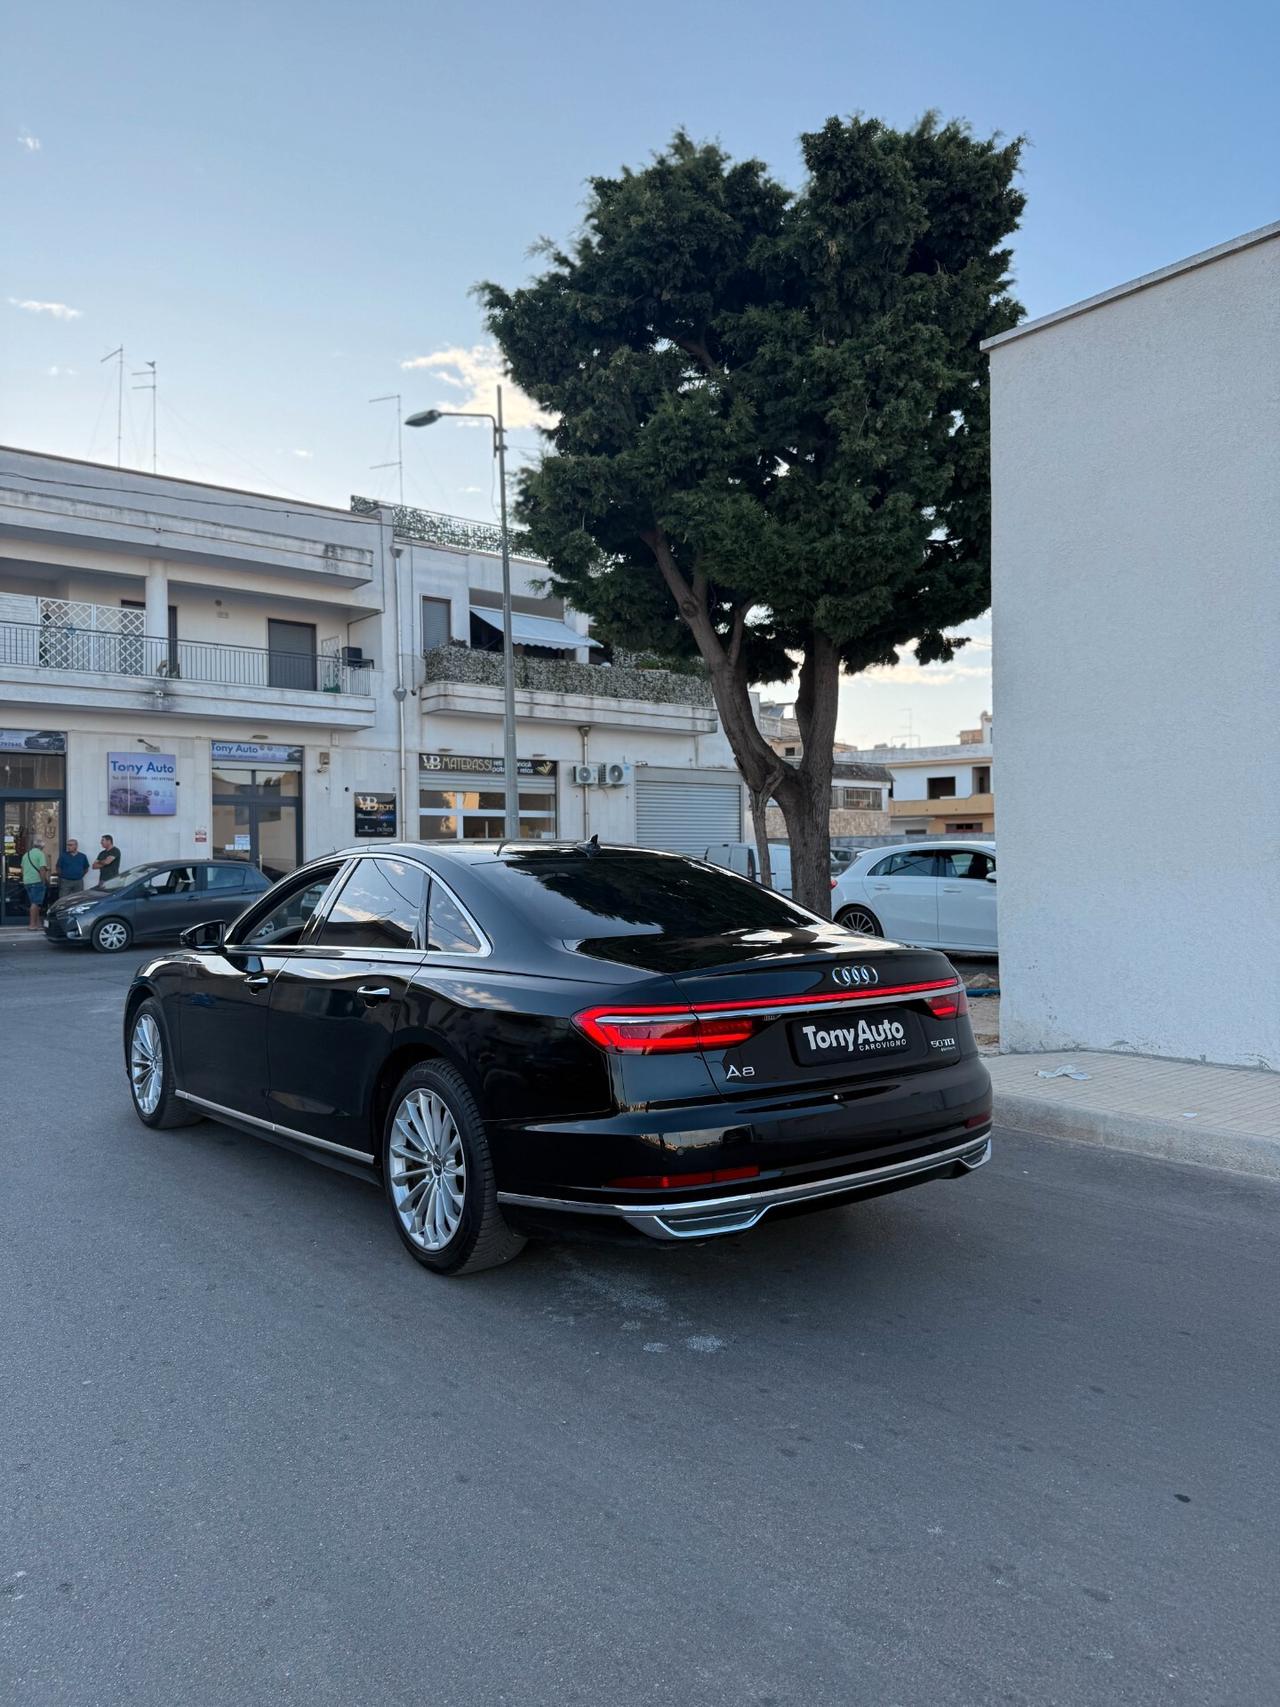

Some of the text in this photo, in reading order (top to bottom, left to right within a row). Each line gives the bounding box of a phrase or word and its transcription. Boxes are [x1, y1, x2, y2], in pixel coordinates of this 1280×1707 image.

[211, 742, 259, 754] Tony Auto
[111, 760, 174, 775] Tony Auto
[442, 756, 492, 771] MATERASSI
[859, 1038, 907, 1051] CAROVIGNO
[930, 1040, 943, 1048] 50
[726, 1064, 755, 1079] A8
